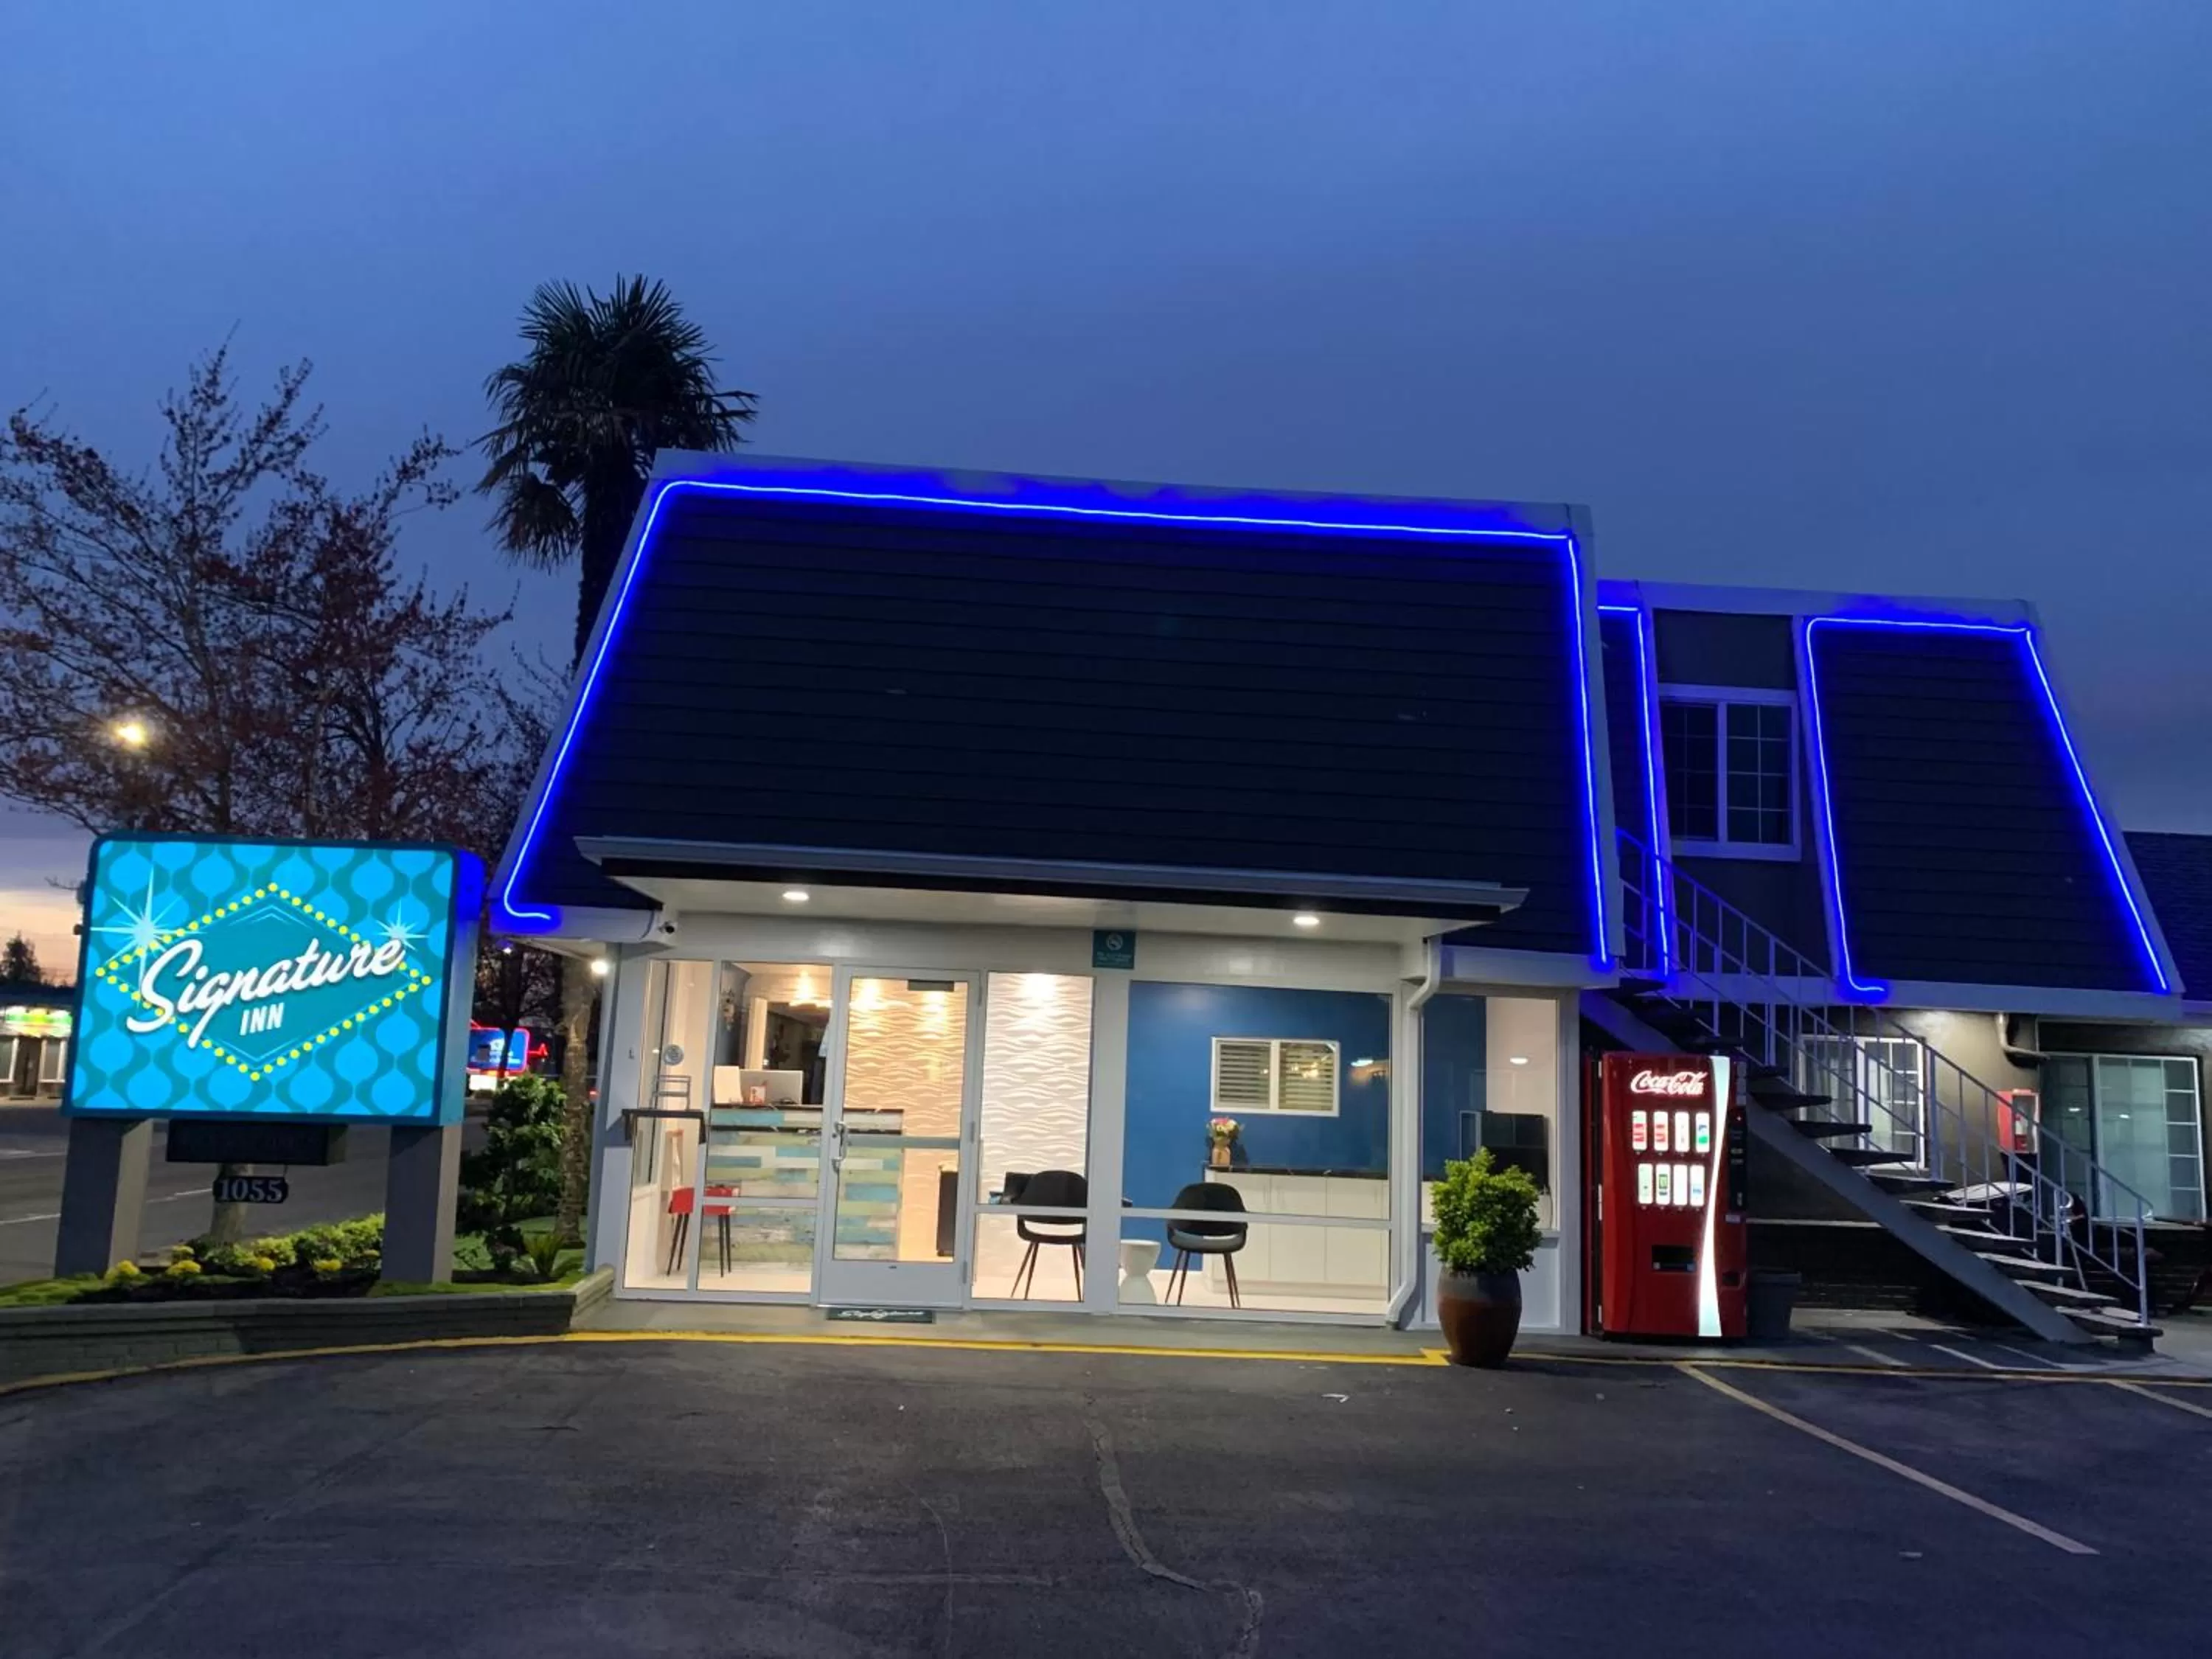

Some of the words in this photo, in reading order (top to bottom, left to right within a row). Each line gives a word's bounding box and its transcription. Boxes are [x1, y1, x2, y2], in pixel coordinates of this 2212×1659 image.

[127, 939, 406, 1048] Signature
[240, 1003, 285, 1036] INN
[220, 1178, 283, 1202] 1055
